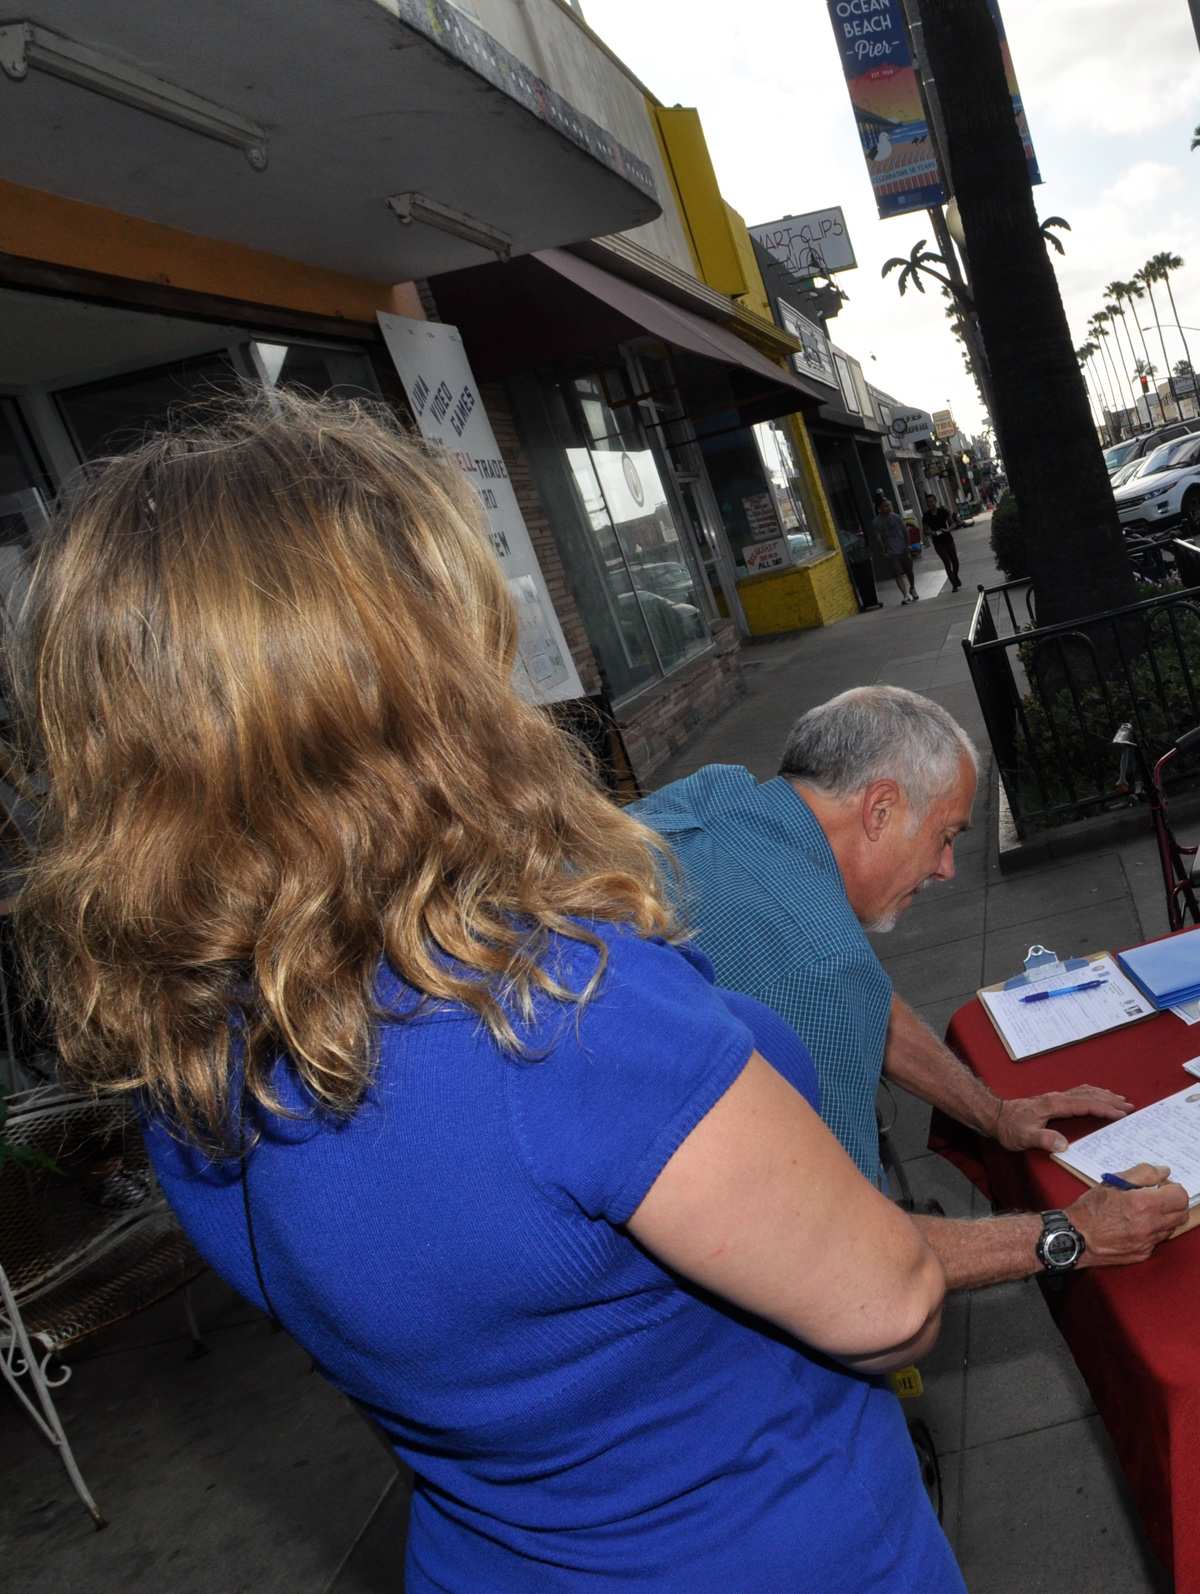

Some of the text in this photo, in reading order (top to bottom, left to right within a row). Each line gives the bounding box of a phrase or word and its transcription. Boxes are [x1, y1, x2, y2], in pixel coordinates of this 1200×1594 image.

[843, 13, 892, 38] BEACH
[800, 218, 843, 243] CLIPS
[430, 380, 453, 425] VIDEO
[450, 384, 475, 438] GAMES
[475, 459, 508, 479] TRADE
